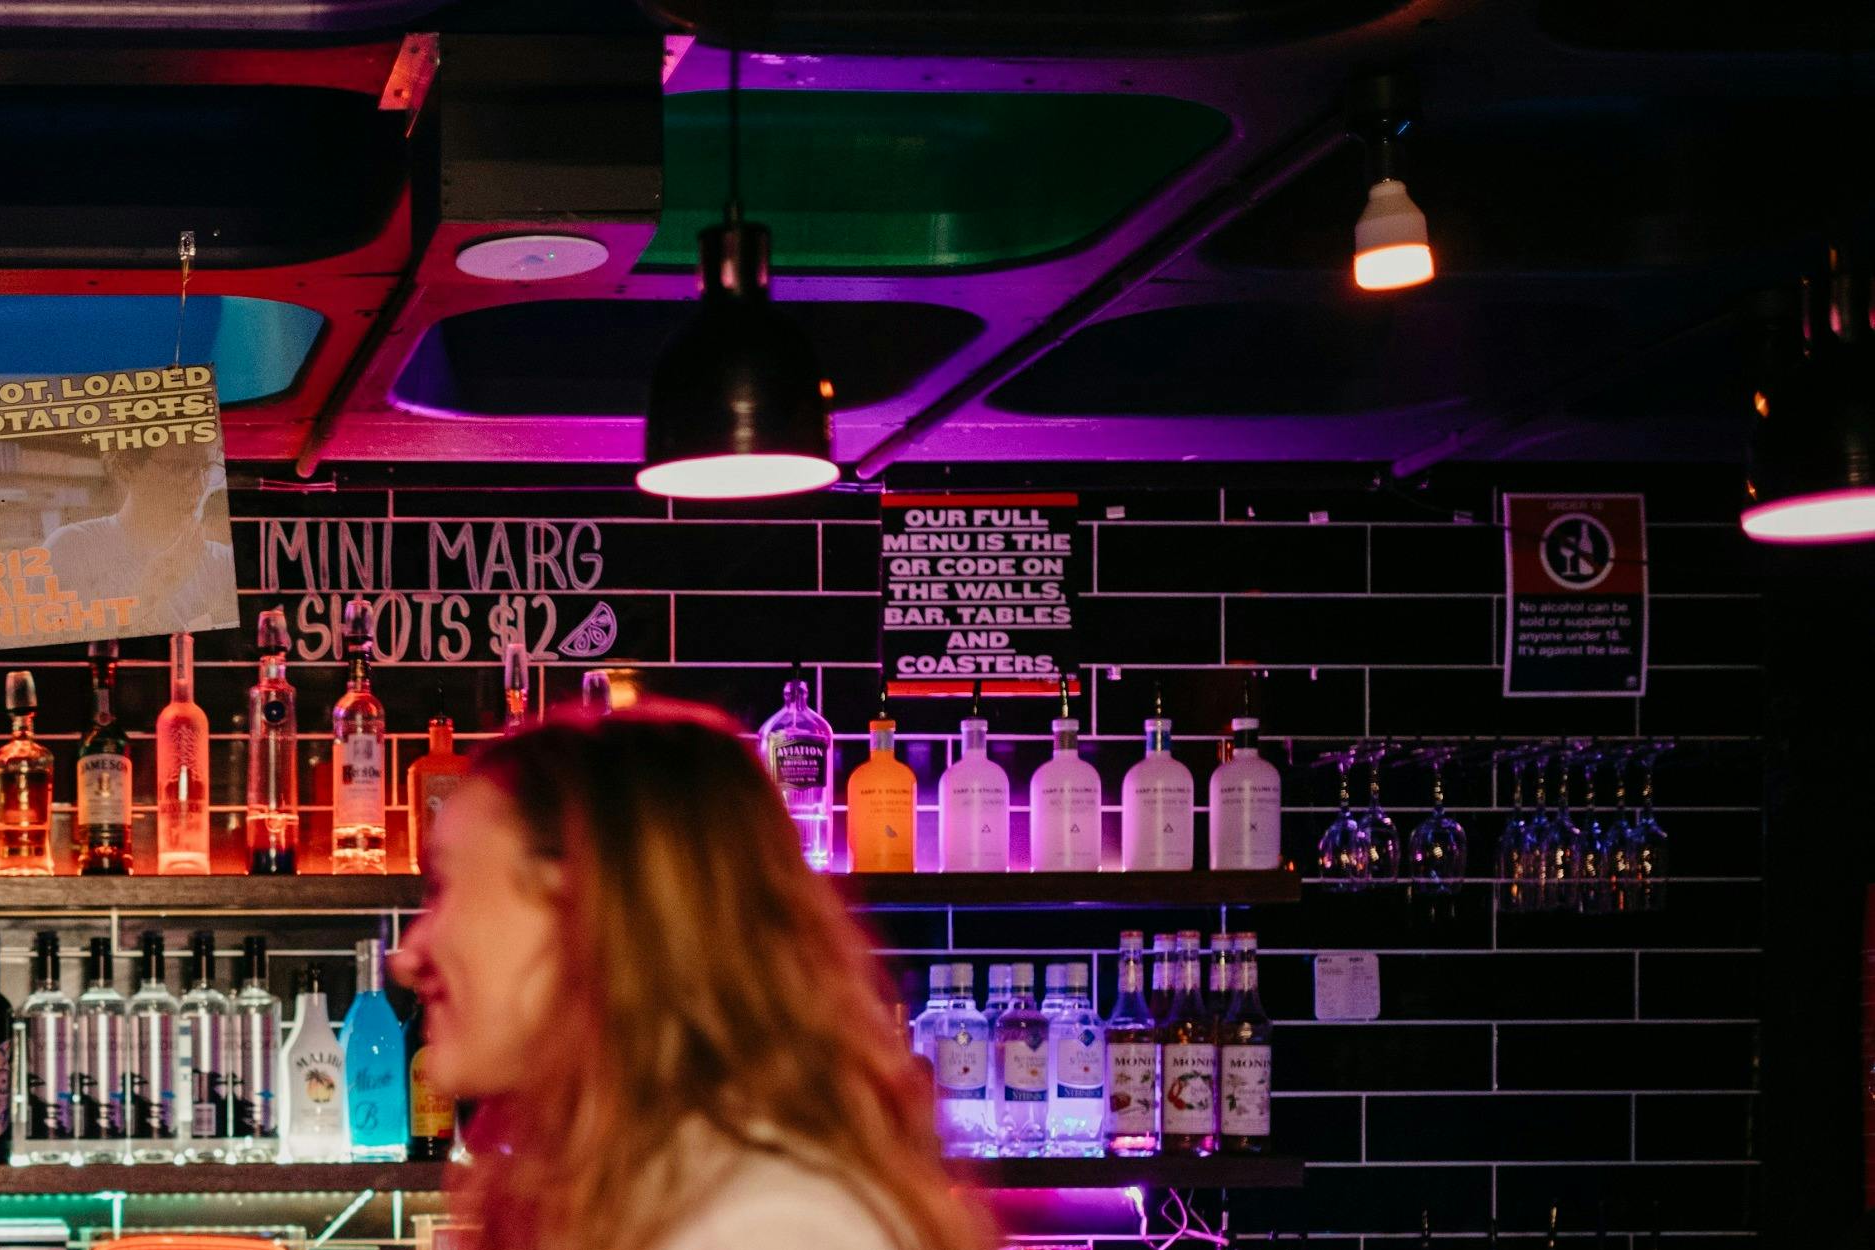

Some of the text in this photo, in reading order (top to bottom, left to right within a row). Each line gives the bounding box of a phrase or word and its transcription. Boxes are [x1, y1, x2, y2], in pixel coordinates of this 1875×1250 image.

[61, 366, 212, 399] LOADED
[905, 509, 1049, 526] OUR FULL
[882, 533, 1071, 551] MENU IS THE
[268, 519, 603, 592] MINI MARG
[889, 558, 1063, 575] QR CODE ON
[888, 582, 1066, 602] THE WALLS,
[884, 606, 1072, 626] BAR, TABLES
[947, 631, 1010, 648] AND
[897, 655, 1059, 673] COASTERS.
[776, 745, 823, 758] AVIATION
[80, 758, 129, 772] AMESO
